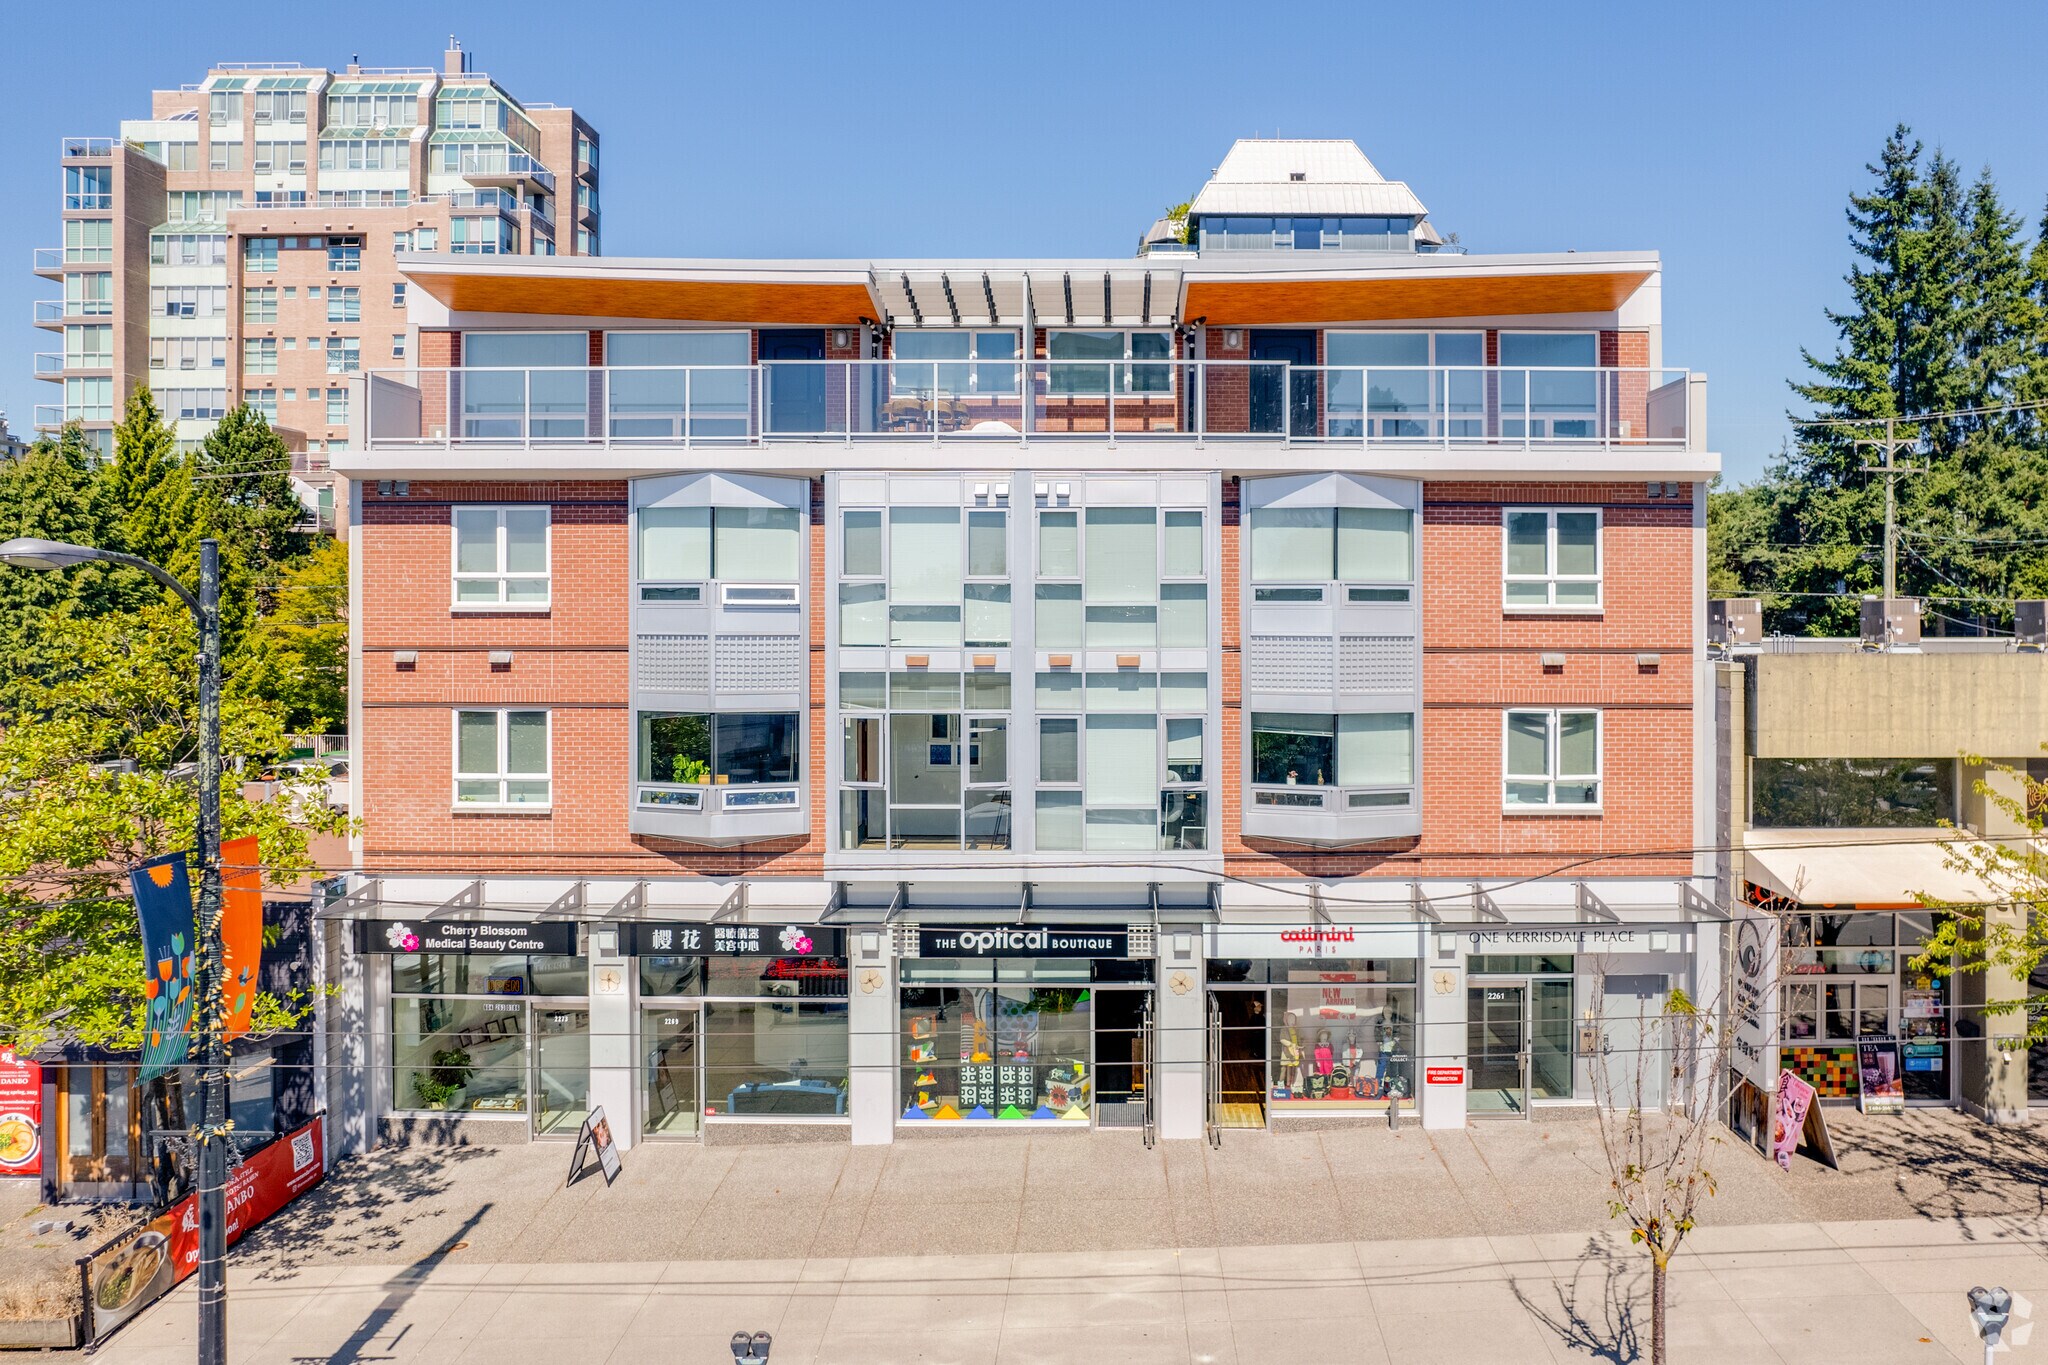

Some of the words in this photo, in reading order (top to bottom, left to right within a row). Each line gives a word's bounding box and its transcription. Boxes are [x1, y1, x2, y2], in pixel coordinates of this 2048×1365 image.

[441, 925, 477, 938] Cherry
[480, 925, 527, 936] Blossom
[1280, 926, 1355, 942] catimini
[1469, 931, 1499, 944] ONE
[1506, 931, 1586, 943] KERRISDALE
[1594, 930, 1635, 942] PLACE
[425, 938, 466, 949] Medical
[469, 938, 506, 951] Beauty
[508, 938, 544, 949] Centre
[714, 940, 760, 951] 美容中心
[935, 939, 957, 949] THE
[959, 927, 1048, 954] optical
[1052, 938, 1112, 949] BOUTIQUE
[1299, 945, 1336, 953] PARIS
[487, 980, 520, 992] OPEN
[1322, 987, 1341, 999] NEW
[1487, 992, 1505, 1000] 2261
[1326, 997, 1355, 1006] ARRIVALS
[1861, 1044, 1879, 1052] TEA
[226, 1185, 255, 1215] ANBO
